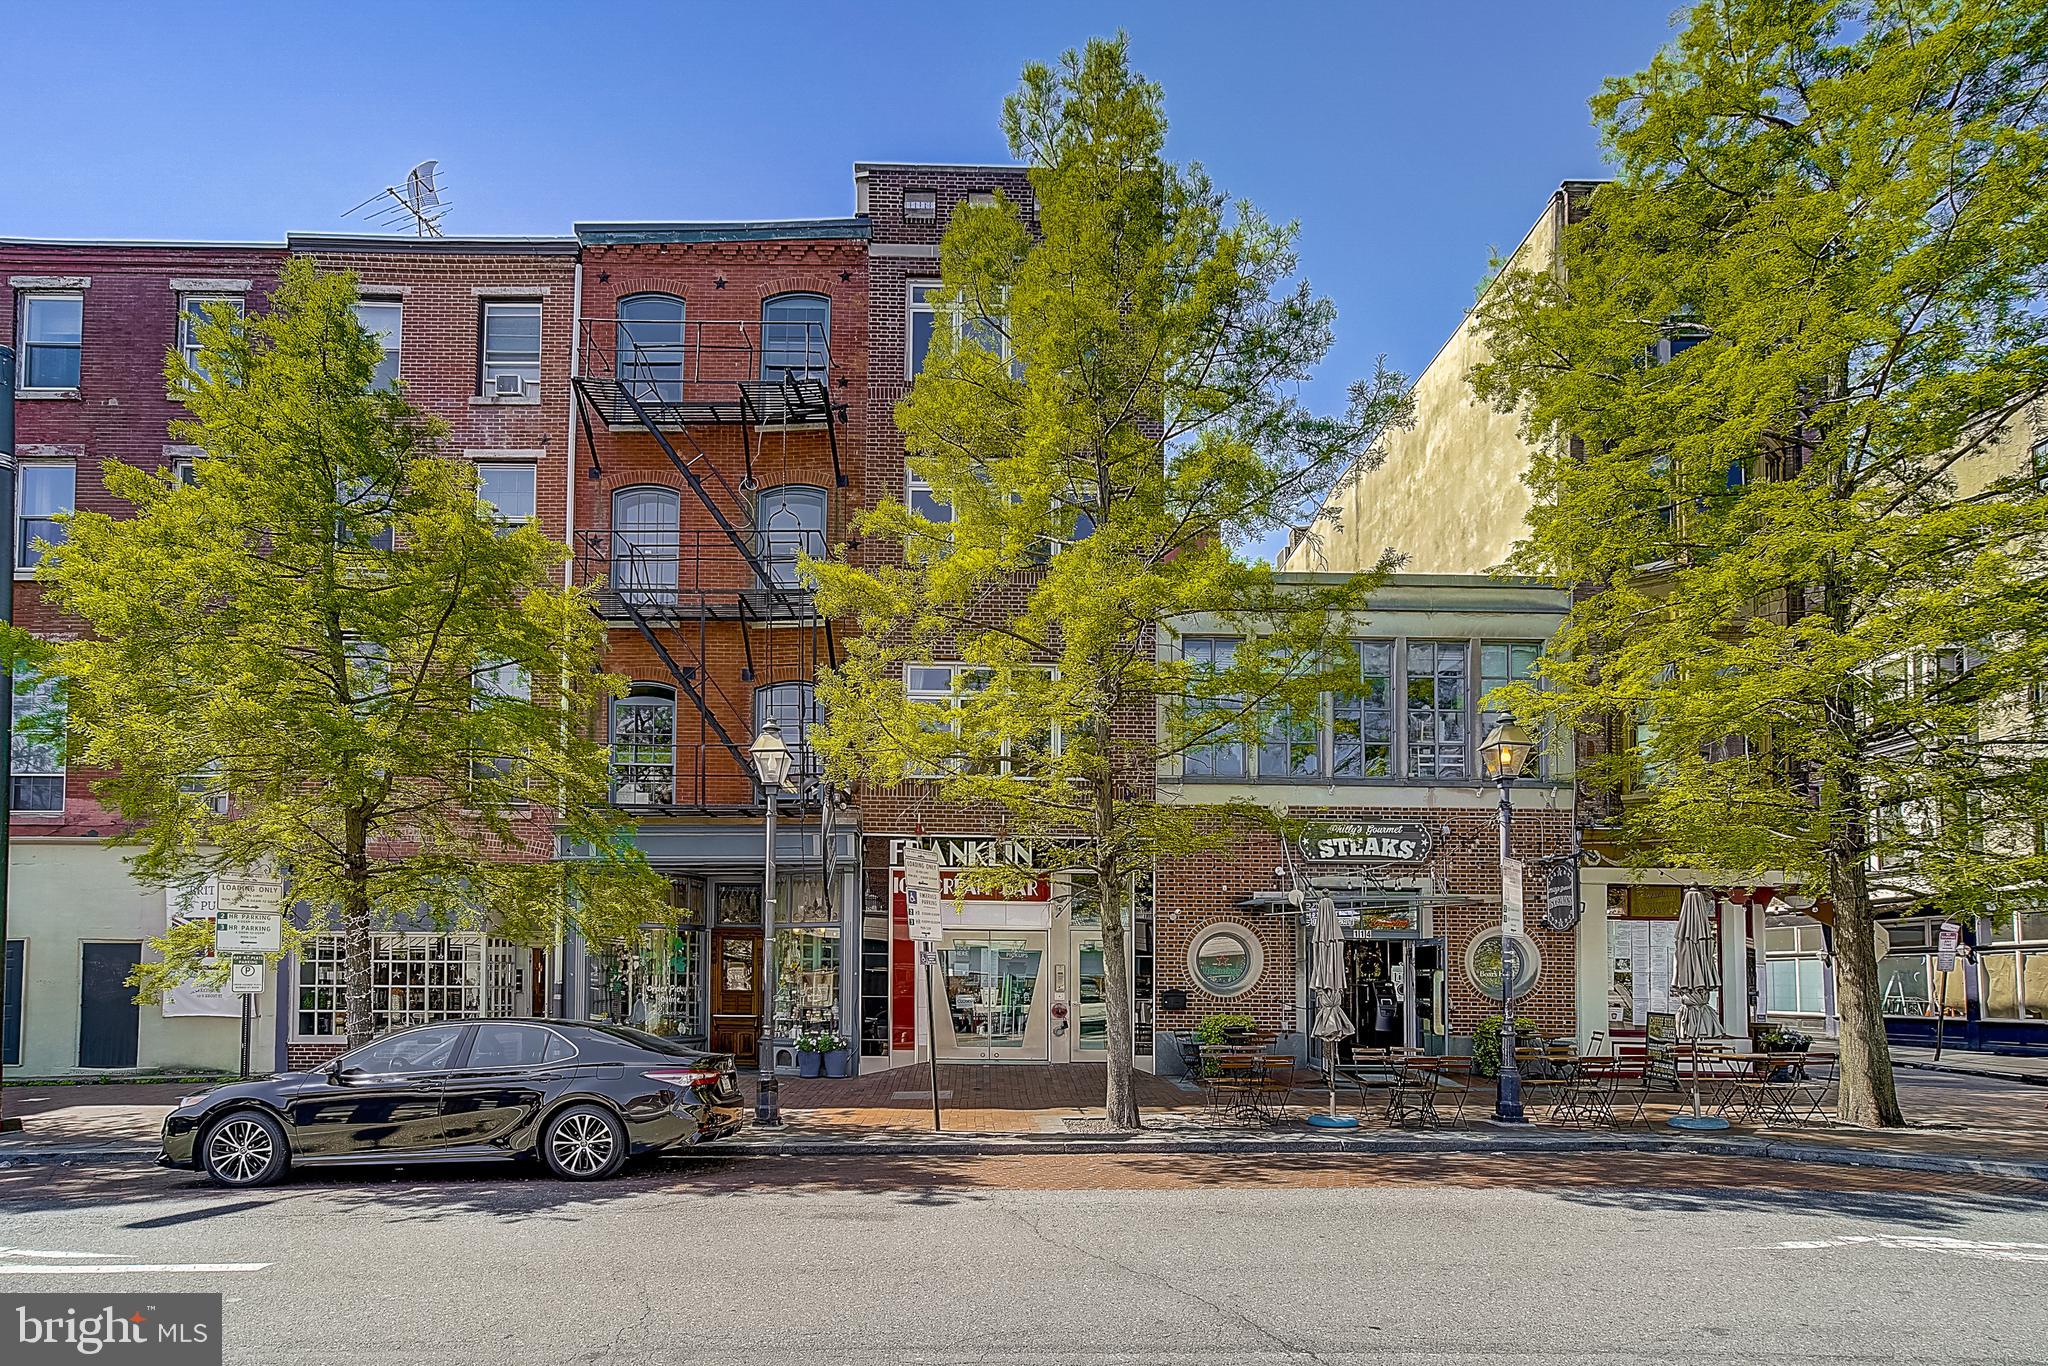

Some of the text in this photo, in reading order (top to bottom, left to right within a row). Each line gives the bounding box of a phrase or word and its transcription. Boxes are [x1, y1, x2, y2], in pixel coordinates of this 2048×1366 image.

[1366, 825, 1403, 835] Gourmet
[1318, 837, 1417, 859] STEAKS
[222, 883, 278, 894] LOADING ONLY
[1354, 929, 1371, 938] 114
